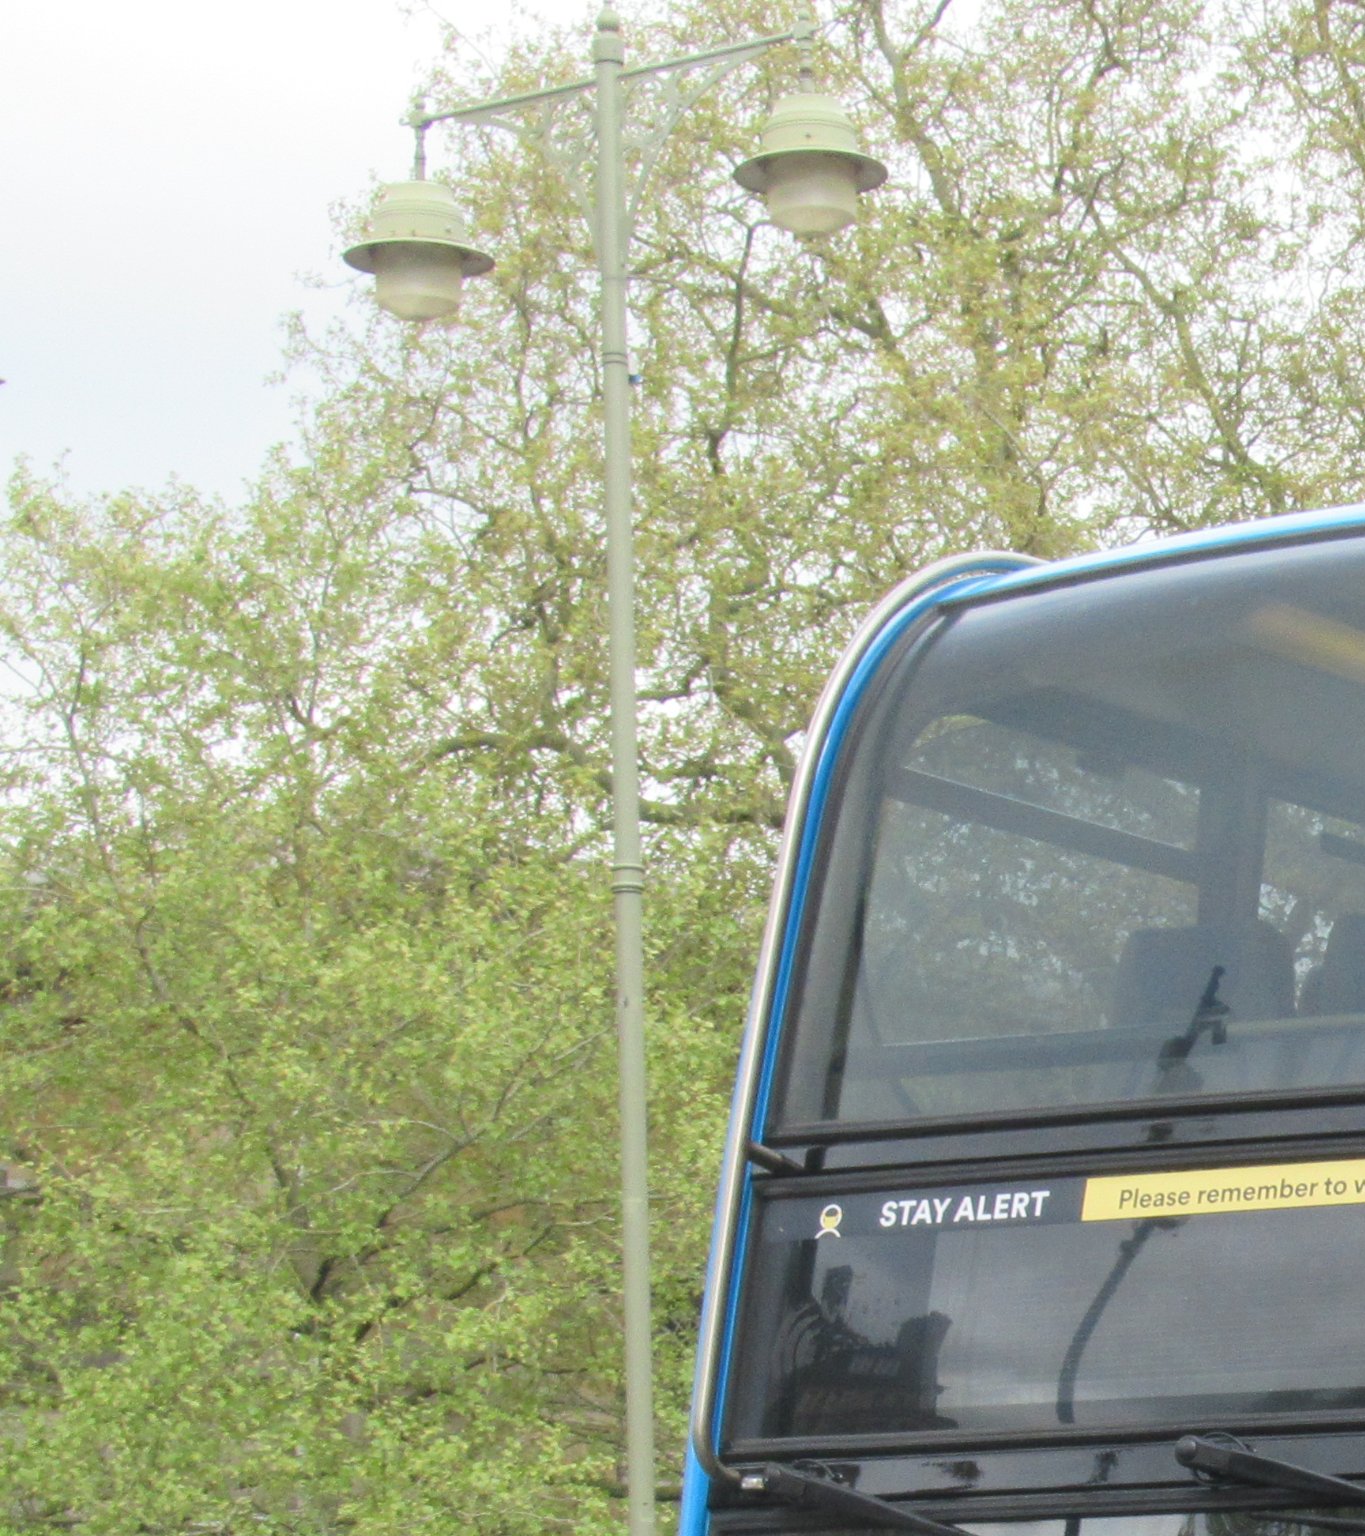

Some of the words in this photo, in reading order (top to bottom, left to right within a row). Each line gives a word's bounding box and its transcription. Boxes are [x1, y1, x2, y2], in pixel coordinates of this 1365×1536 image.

[879, 1197, 954, 1229] STAY
[954, 1190, 1050, 1223] ALERT
[1118, 1188, 1191, 1210] Please
[1197, 1179, 1319, 1205] remember
[1324, 1178, 1348, 1196] to
